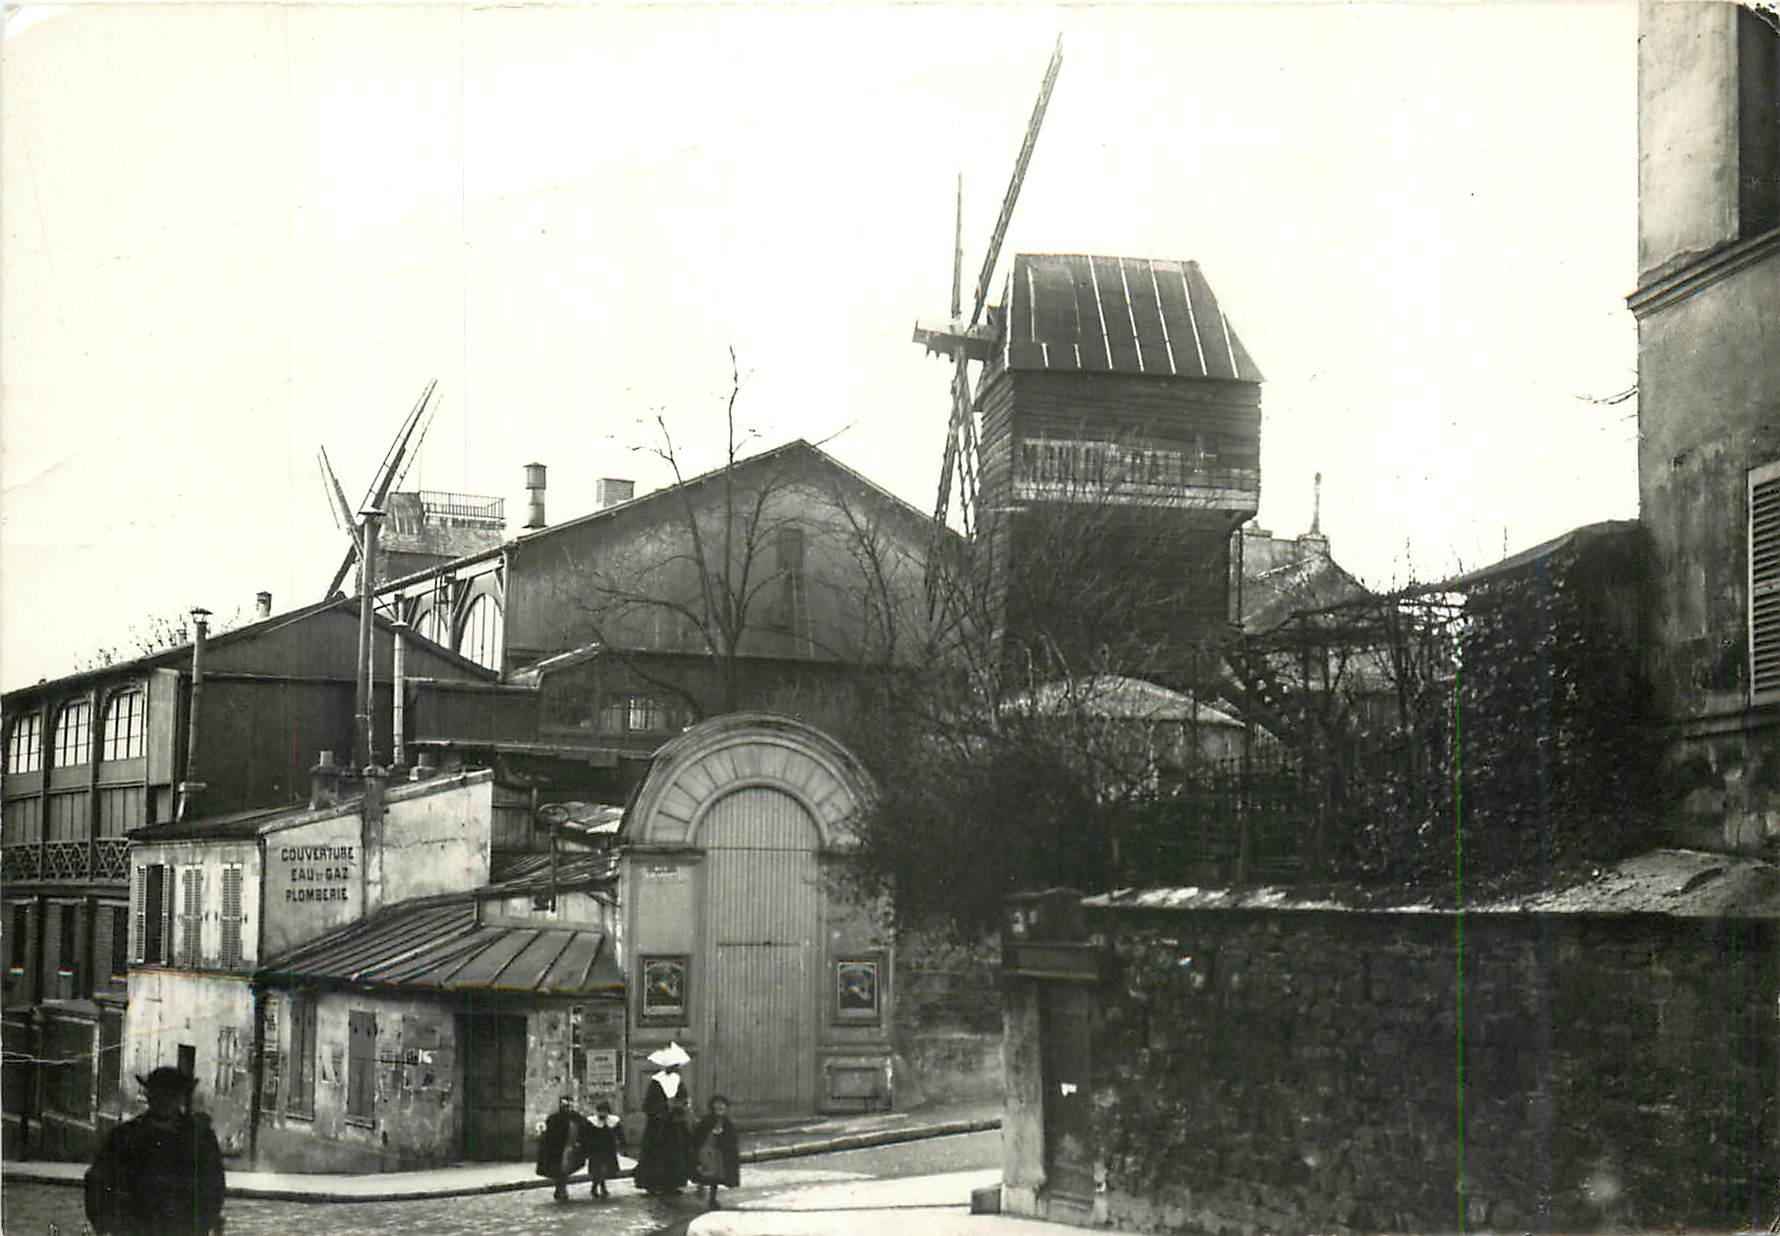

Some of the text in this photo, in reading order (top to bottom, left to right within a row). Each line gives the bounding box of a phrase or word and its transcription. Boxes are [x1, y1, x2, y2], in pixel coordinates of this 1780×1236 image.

[281, 846, 354, 861] COUVERTURE
[291, 868, 314, 882] EAU
[325, 867, 349, 881] GAZ
[286, 887, 348, 902] PLOMBERIE
